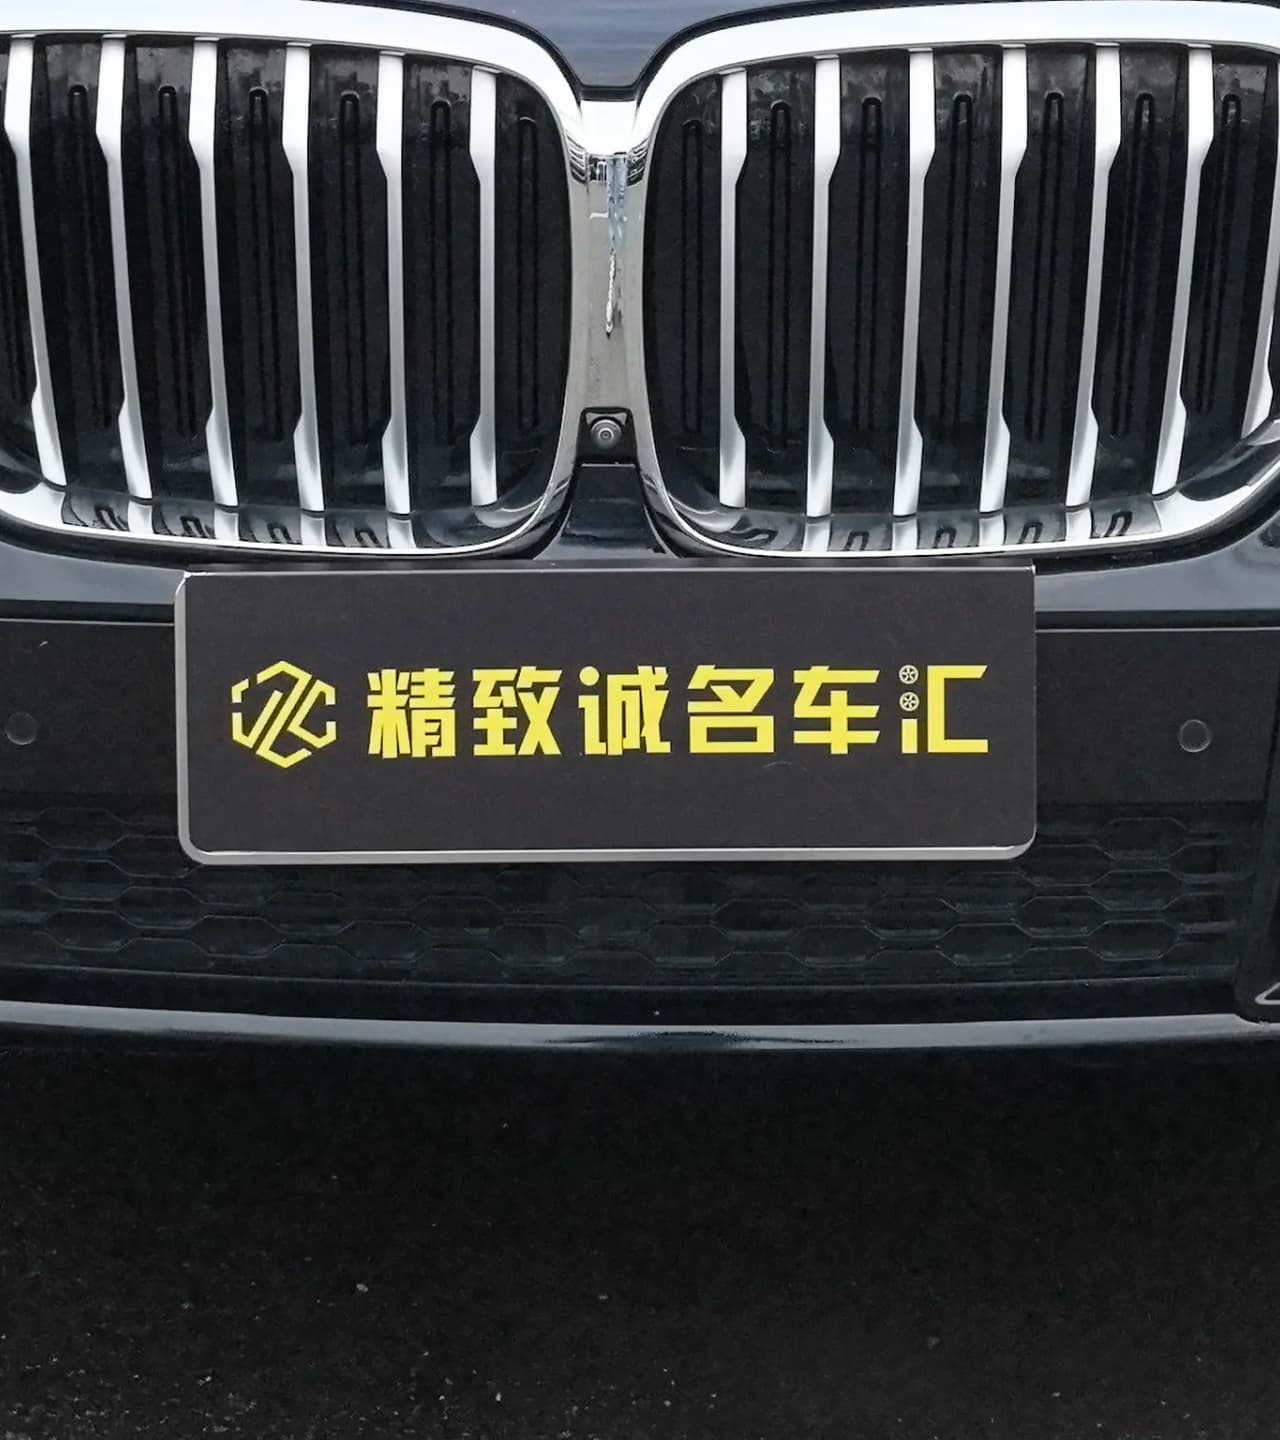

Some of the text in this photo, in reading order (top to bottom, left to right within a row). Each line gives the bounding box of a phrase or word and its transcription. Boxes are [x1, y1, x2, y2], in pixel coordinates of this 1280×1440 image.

[366, 663, 989, 759] 精致诚名车汇
